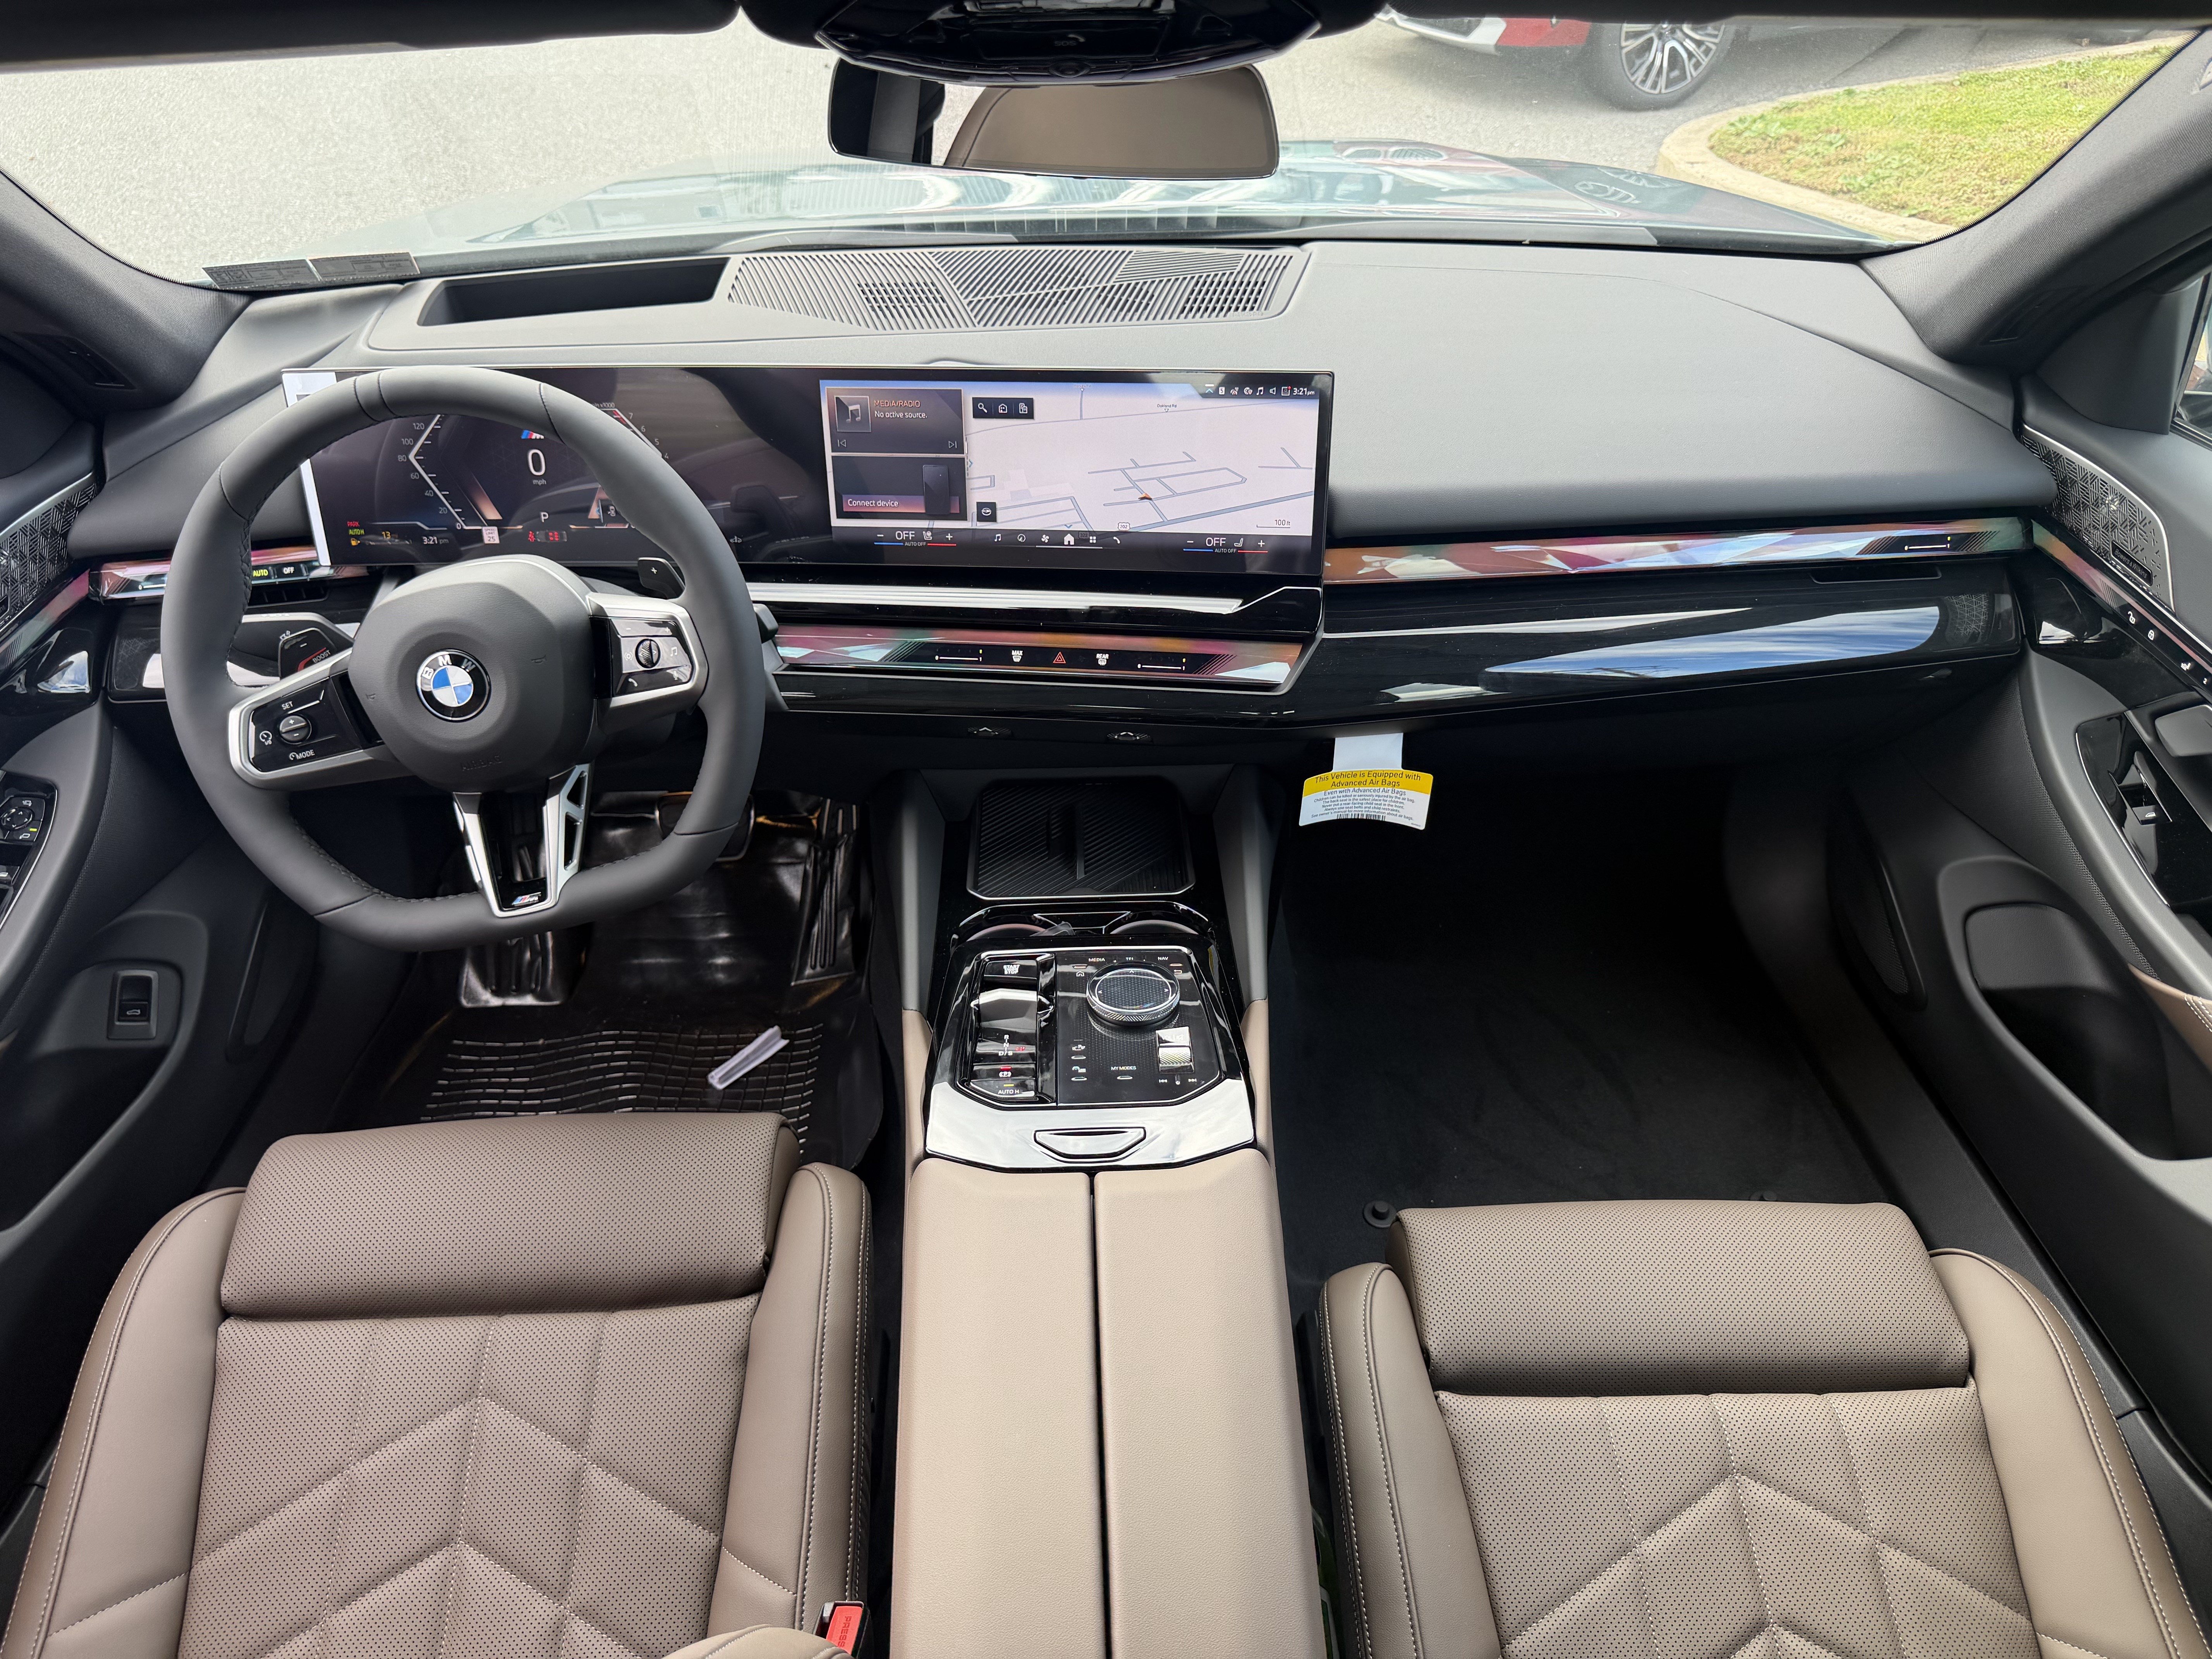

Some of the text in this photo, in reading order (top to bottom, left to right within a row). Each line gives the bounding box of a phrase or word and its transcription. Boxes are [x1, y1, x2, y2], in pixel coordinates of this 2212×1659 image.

[528, 449, 546, 476] 0
[540, 512, 549, 523] P
[382, 531, 391, 539] 13
[422, 536, 438, 544] 3:21
[896, 531, 915, 540] OFF
[1206, 537, 1226, 546] OFF
[2115, 549, 2130, 564] Bowers
[2132, 562, 2147, 578] Wilkins
[313, 650, 331, 663] BOOST
[422, 654, 476, 680] BMW
[282, 701, 293, 710] SET
[295, 749, 315, 760] MODE
[1315, 775, 1329, 783] This
[1331, 771, 1357, 780] Vehicle
[1367, 771, 1403, 779] Equipped
[1405, 773, 1421, 781] with
[1331, 779, 1367, 788] Advanced
[1381, 779, 1400, 788] Bags
[1391, 788, 1406, 796] Bags
